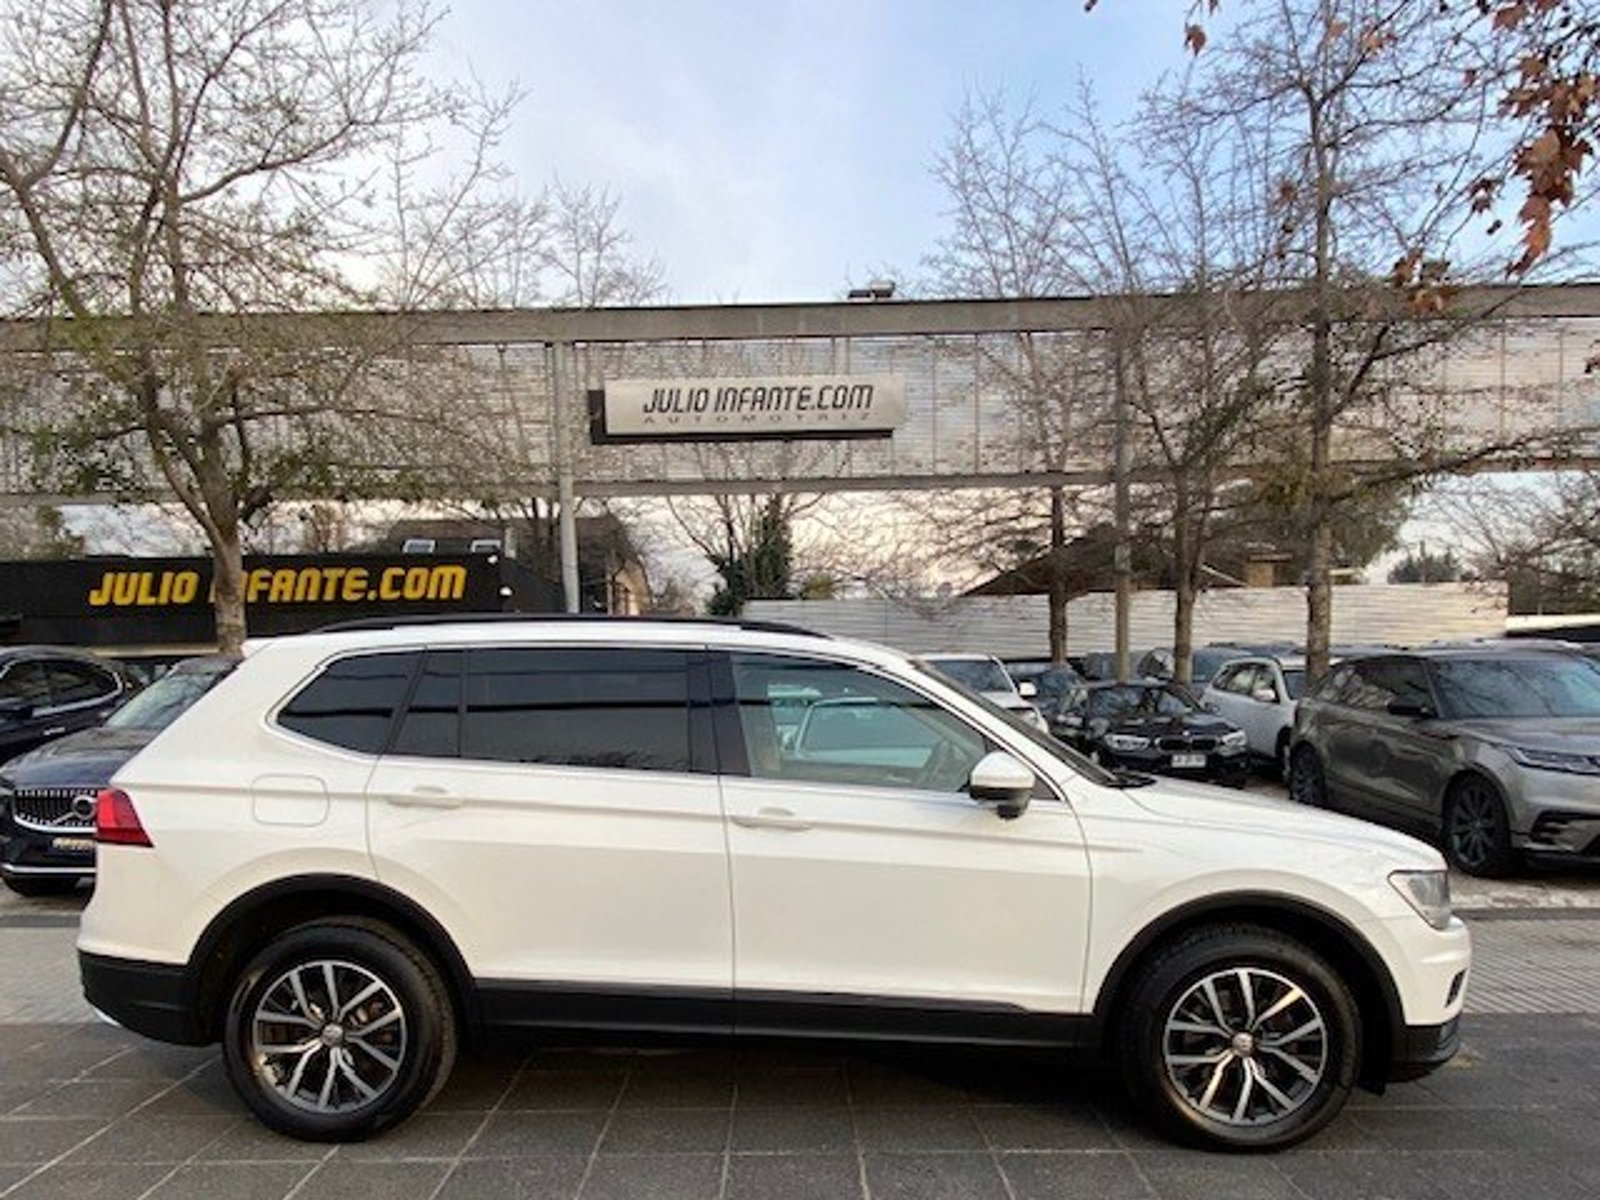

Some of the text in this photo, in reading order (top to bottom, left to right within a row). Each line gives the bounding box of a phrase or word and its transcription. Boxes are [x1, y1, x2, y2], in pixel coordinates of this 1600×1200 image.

[643, 384, 874, 413] JULIO INFANTE.COM
[89, 571, 199, 606] JULIO
